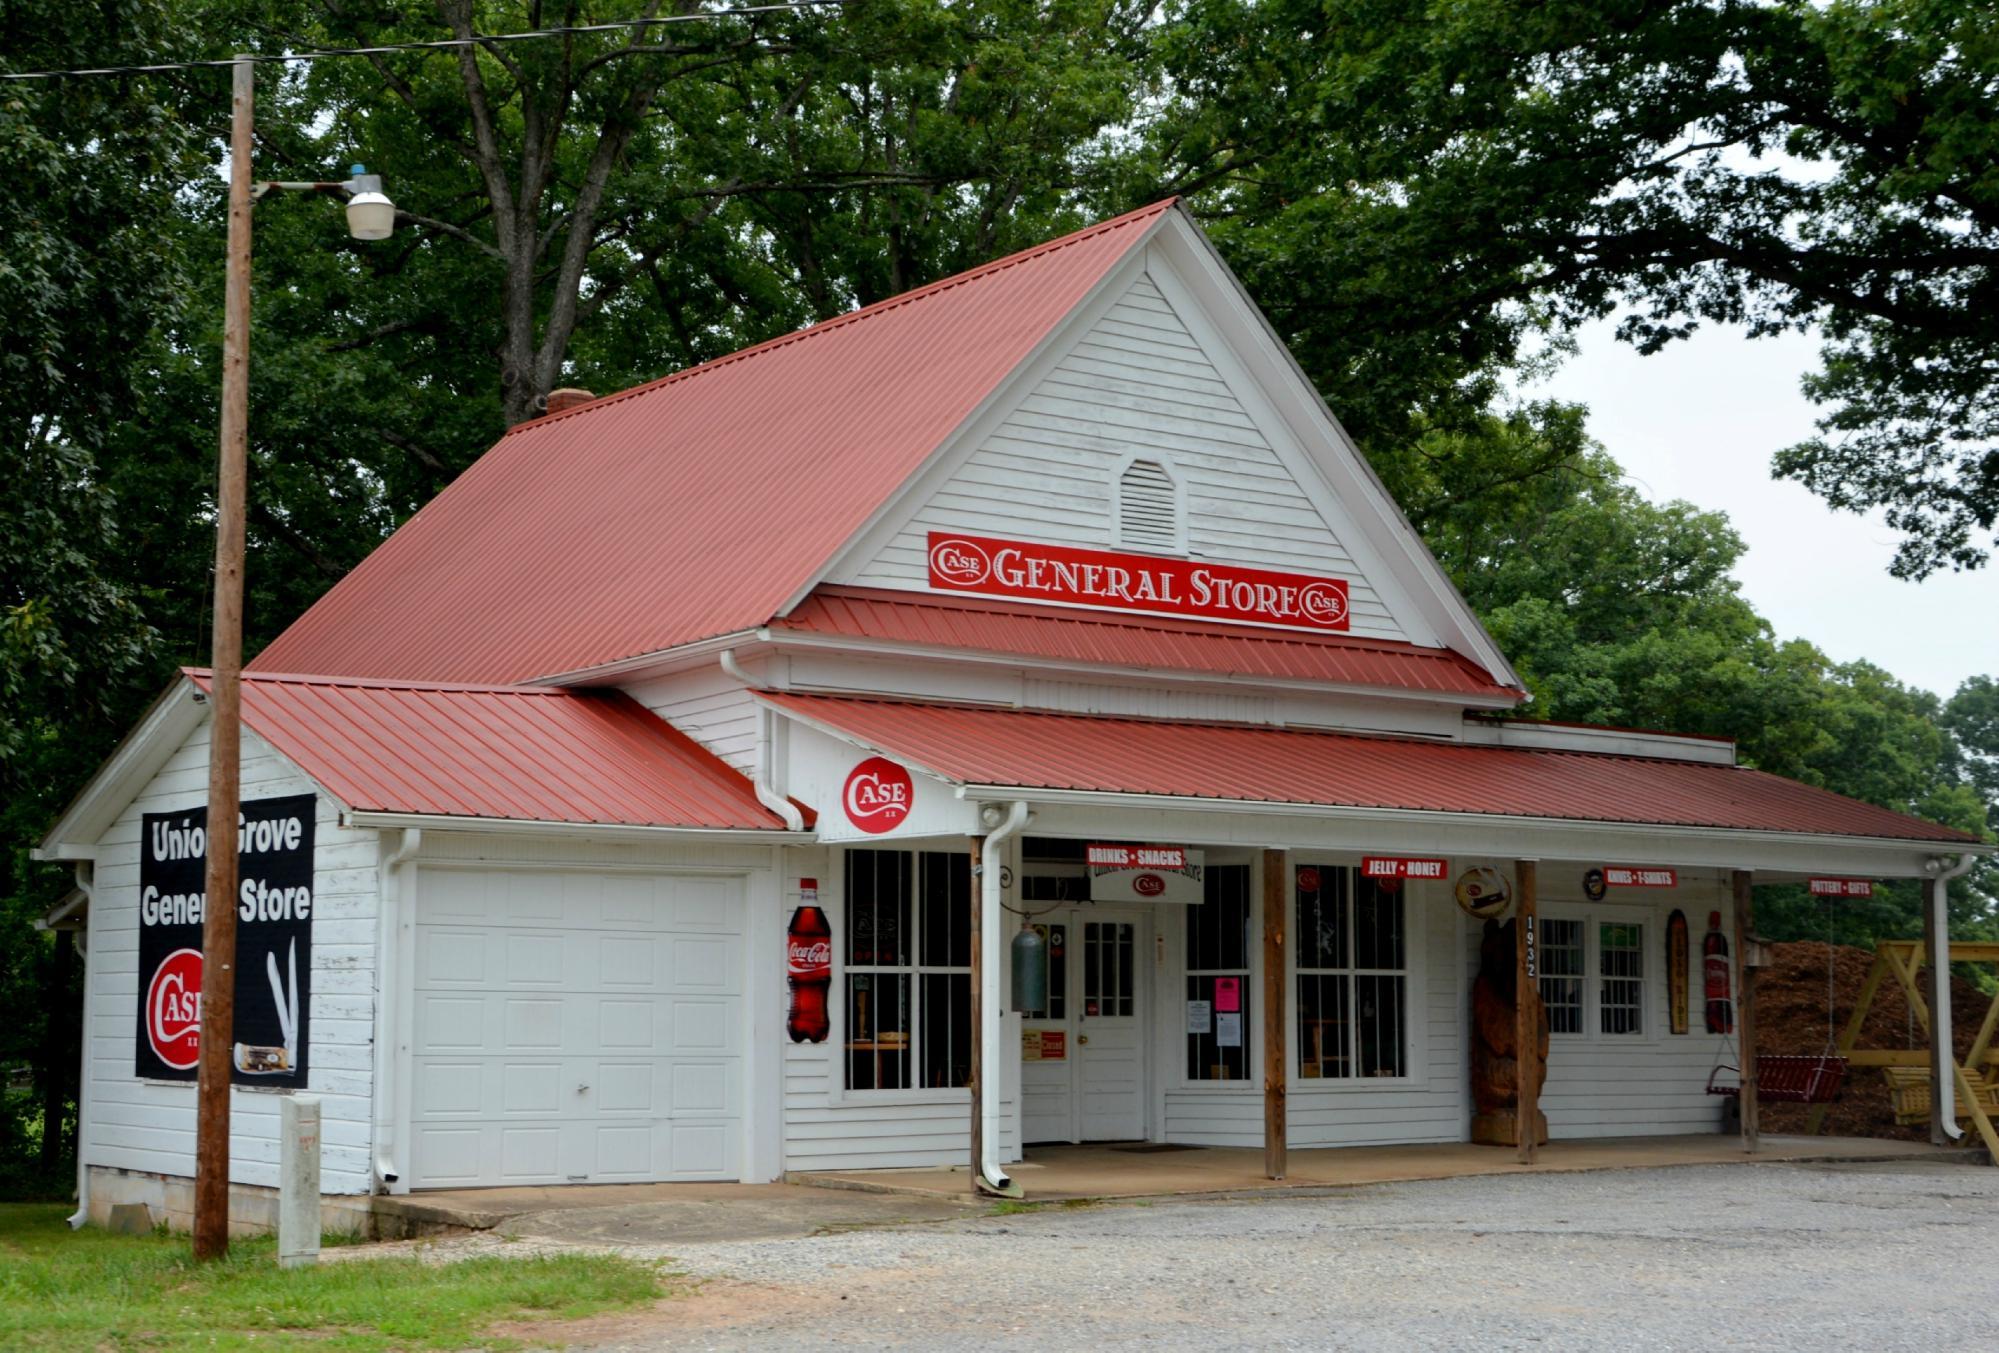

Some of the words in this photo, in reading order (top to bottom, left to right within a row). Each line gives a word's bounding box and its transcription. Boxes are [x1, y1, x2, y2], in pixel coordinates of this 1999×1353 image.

[993, 548, 1181, 606] GENERAL
[1190, 569, 1301, 618] STORE
[152, 818, 208, 861] Unio
[1088, 847, 1129, 864] DRINKS
[1137, 849, 1183, 866] SNACKS
[1368, 860, 1399, 875] JELLY
[1406, 861, 1442, 876] HONEY
[240, 878, 310, 922] Store
[1526, 914, 1536, 978] 1932
